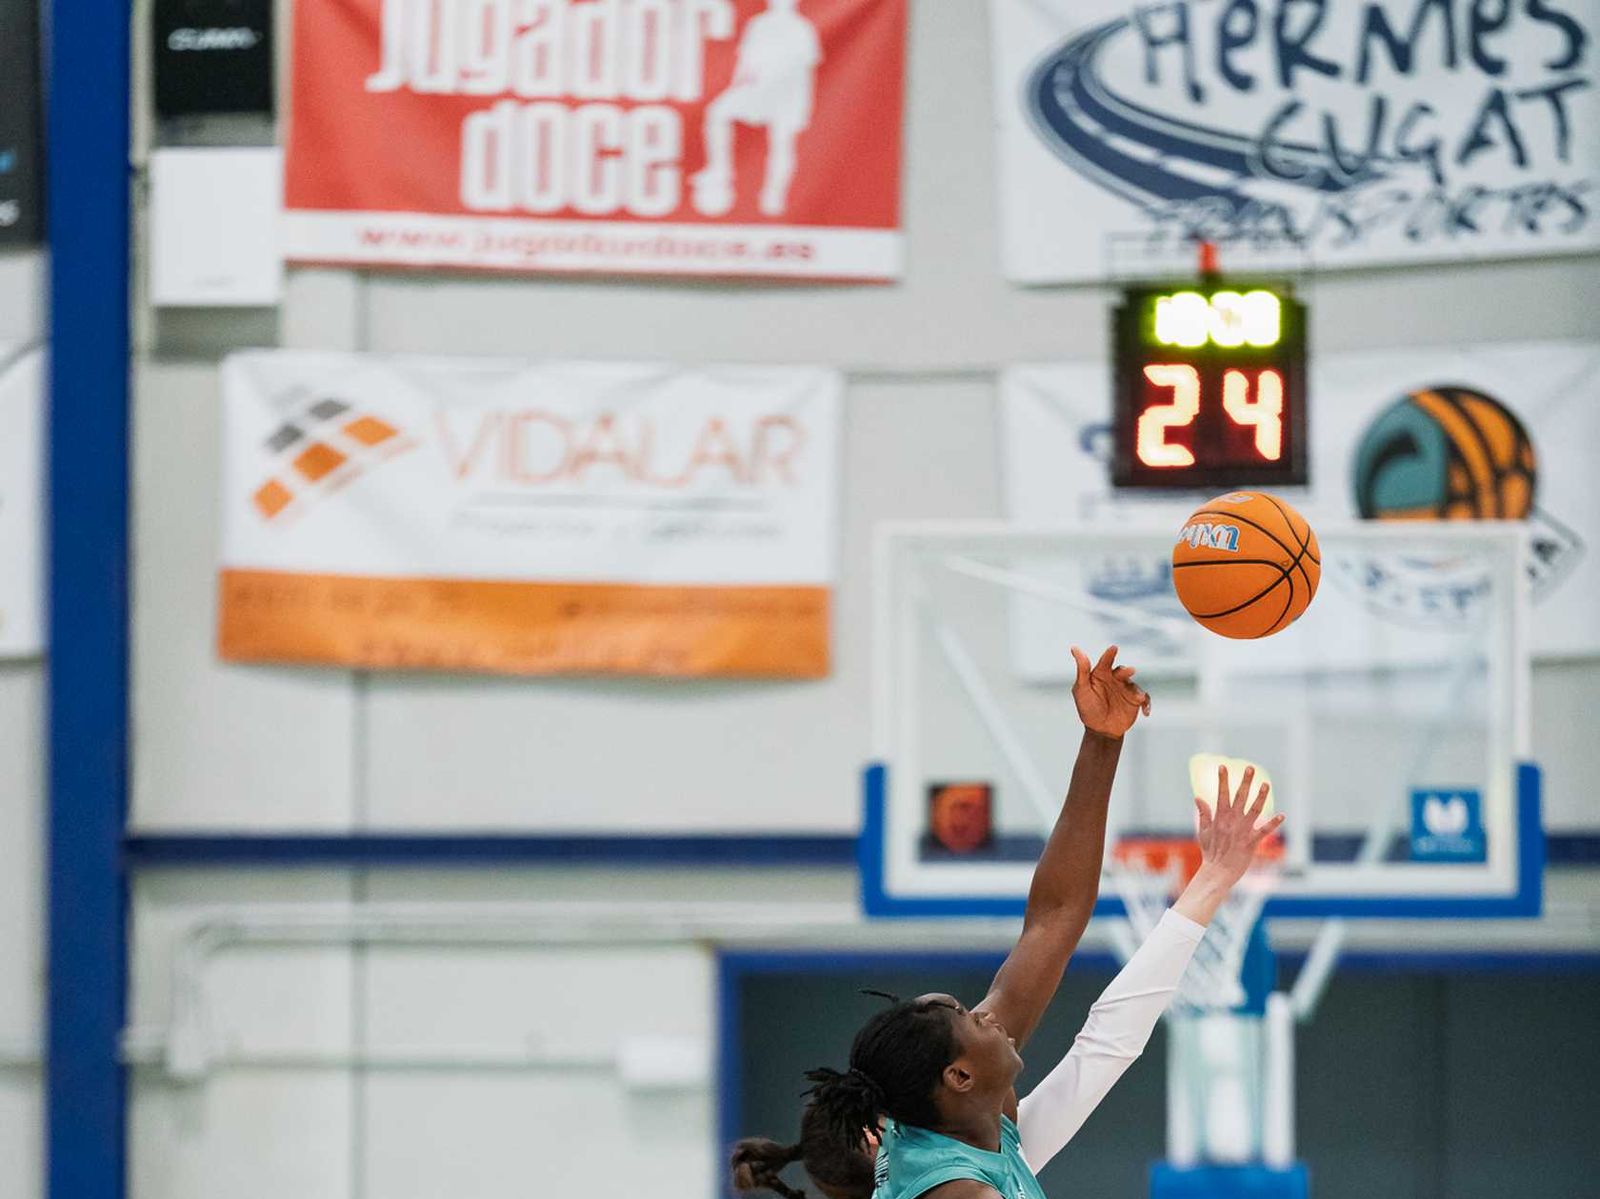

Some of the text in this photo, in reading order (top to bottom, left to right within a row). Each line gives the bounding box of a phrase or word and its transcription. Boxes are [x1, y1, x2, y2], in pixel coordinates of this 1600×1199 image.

[459, 99, 683, 216] doce
[1248, 76, 1592, 186] CUGAT
[434, 408, 809, 487] VIDALAR
[1136, 362, 1284, 468] 24
